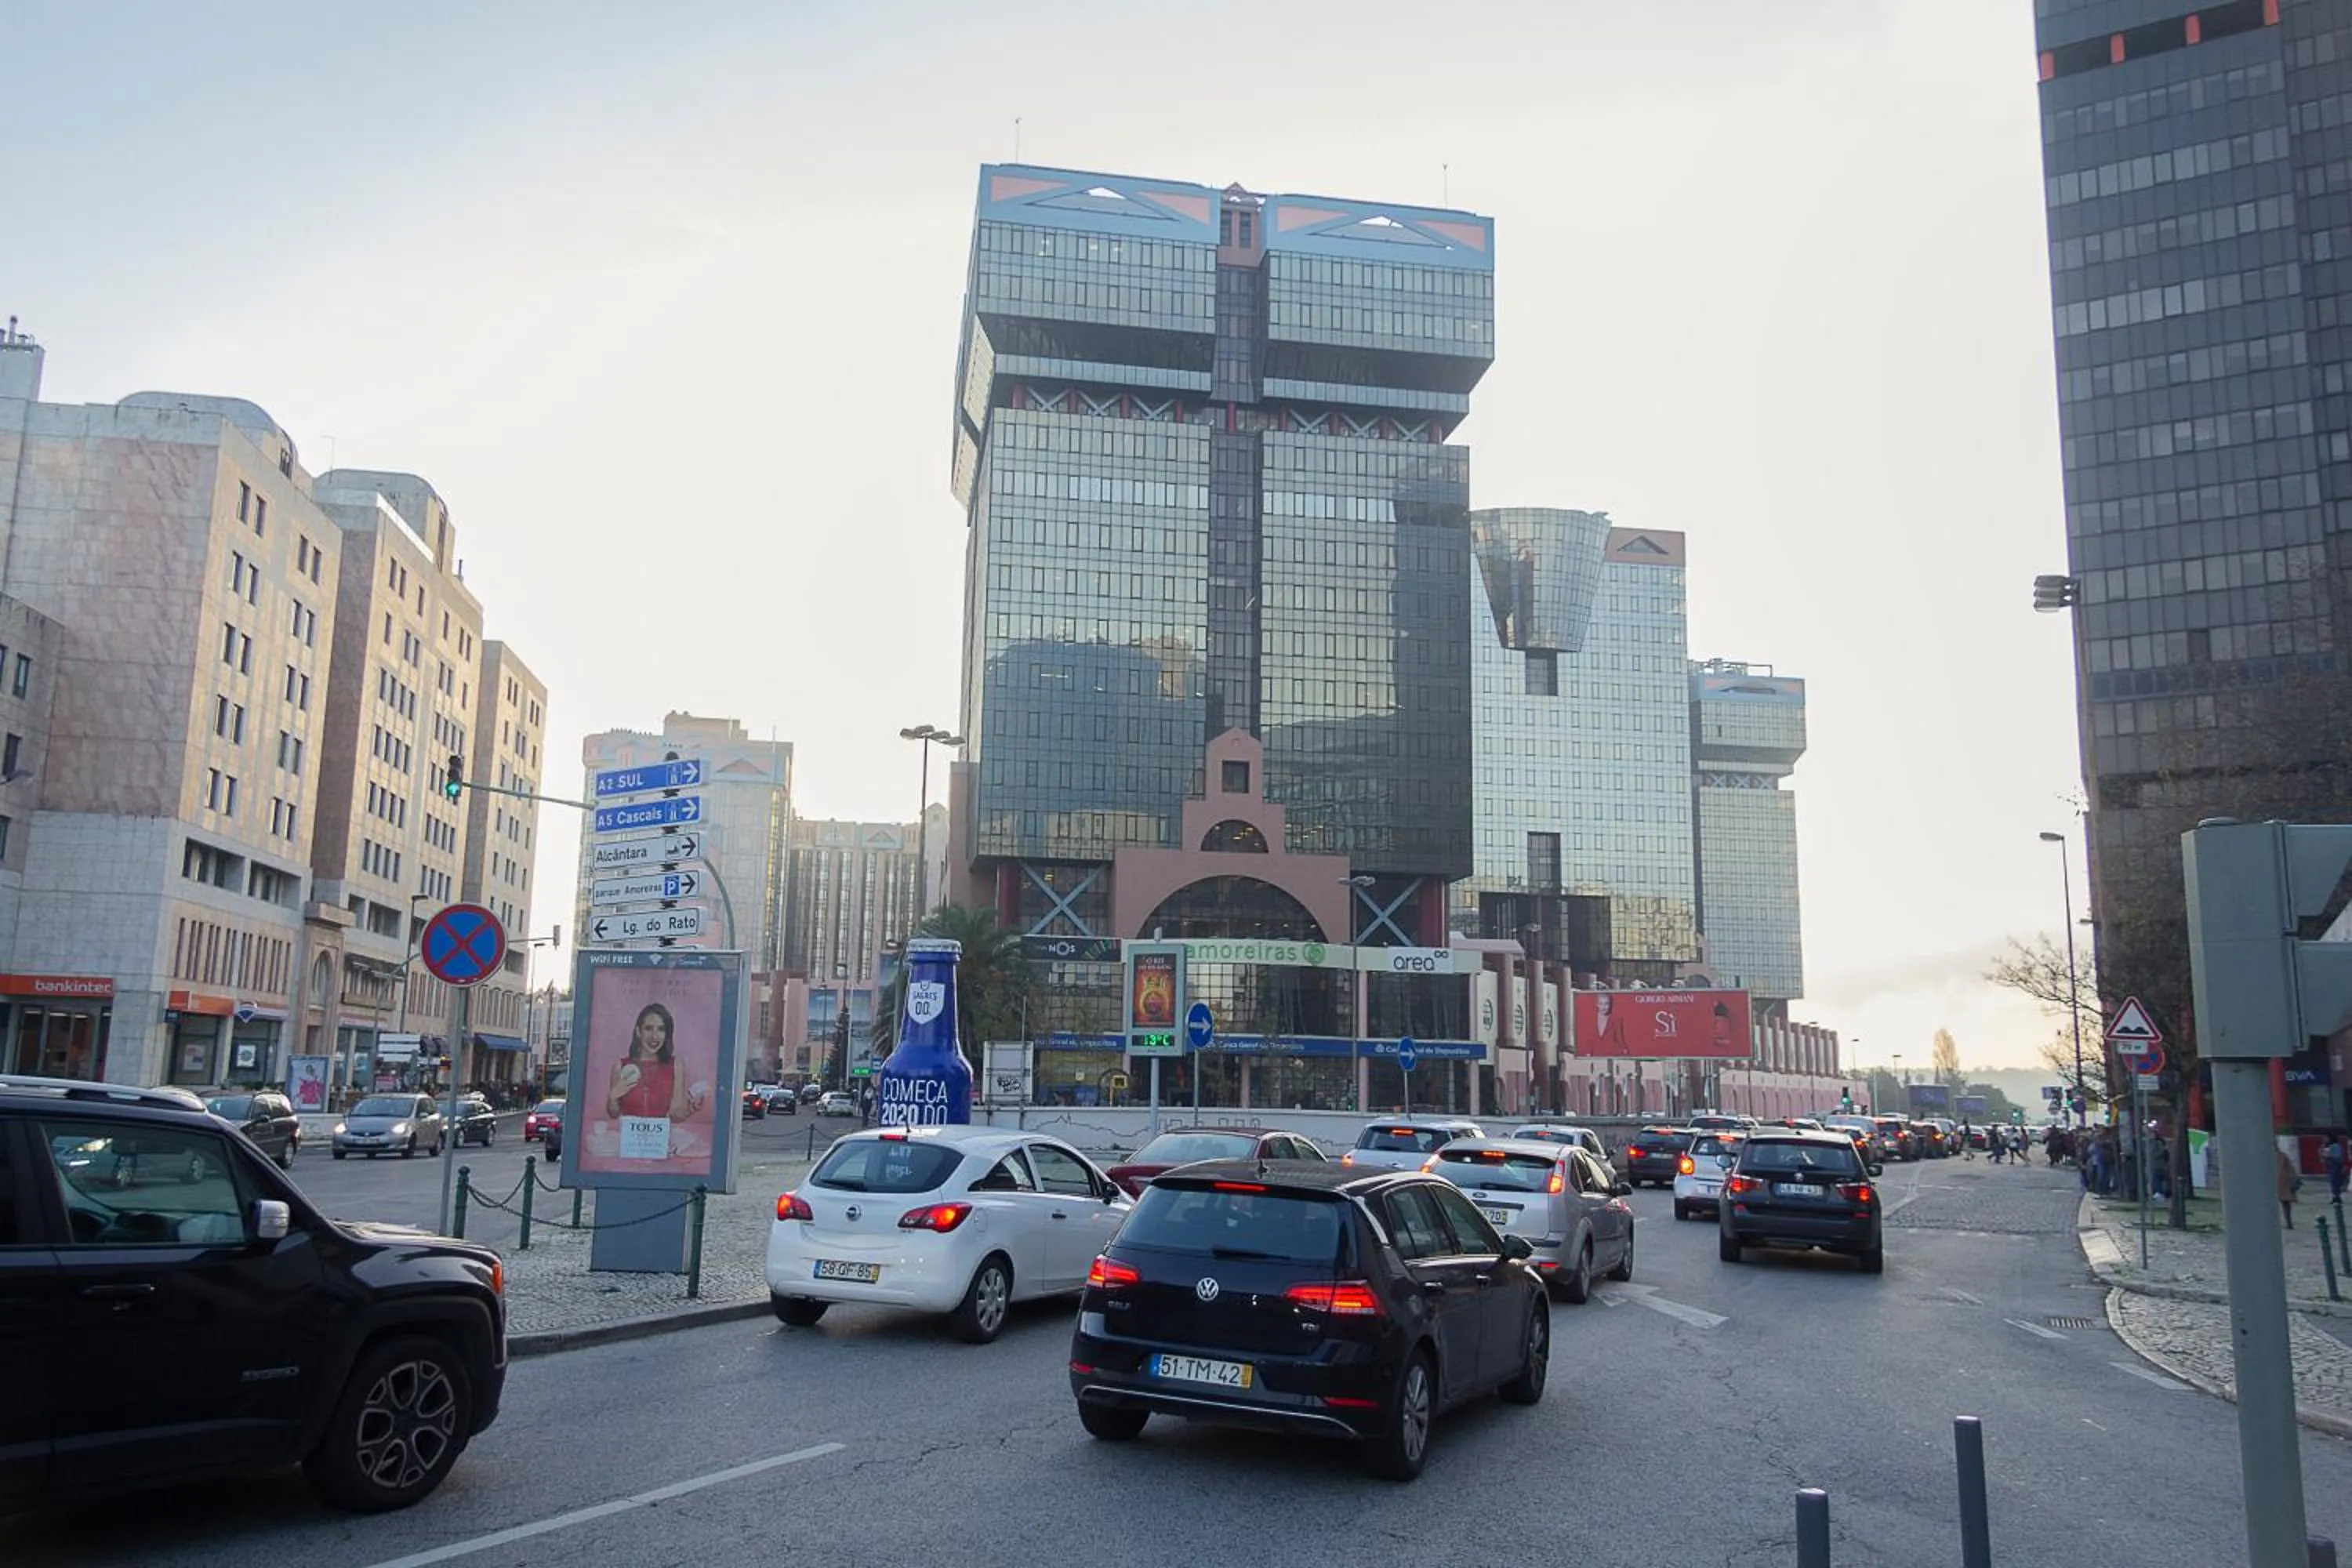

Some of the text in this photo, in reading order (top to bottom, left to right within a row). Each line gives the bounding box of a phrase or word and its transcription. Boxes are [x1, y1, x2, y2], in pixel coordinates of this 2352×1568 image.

[598, 772, 644, 791] A2 SUL
[597, 807, 662, 827] A5 Cascais
[597, 848, 648, 862] Alcântara
[623, 916, 695, 935] Lg. do Rato
[1186, 942, 1298, 961] amoreiras
[880, 1102, 920, 1125] 2020
[629, 1122, 663, 1133] TOUS
